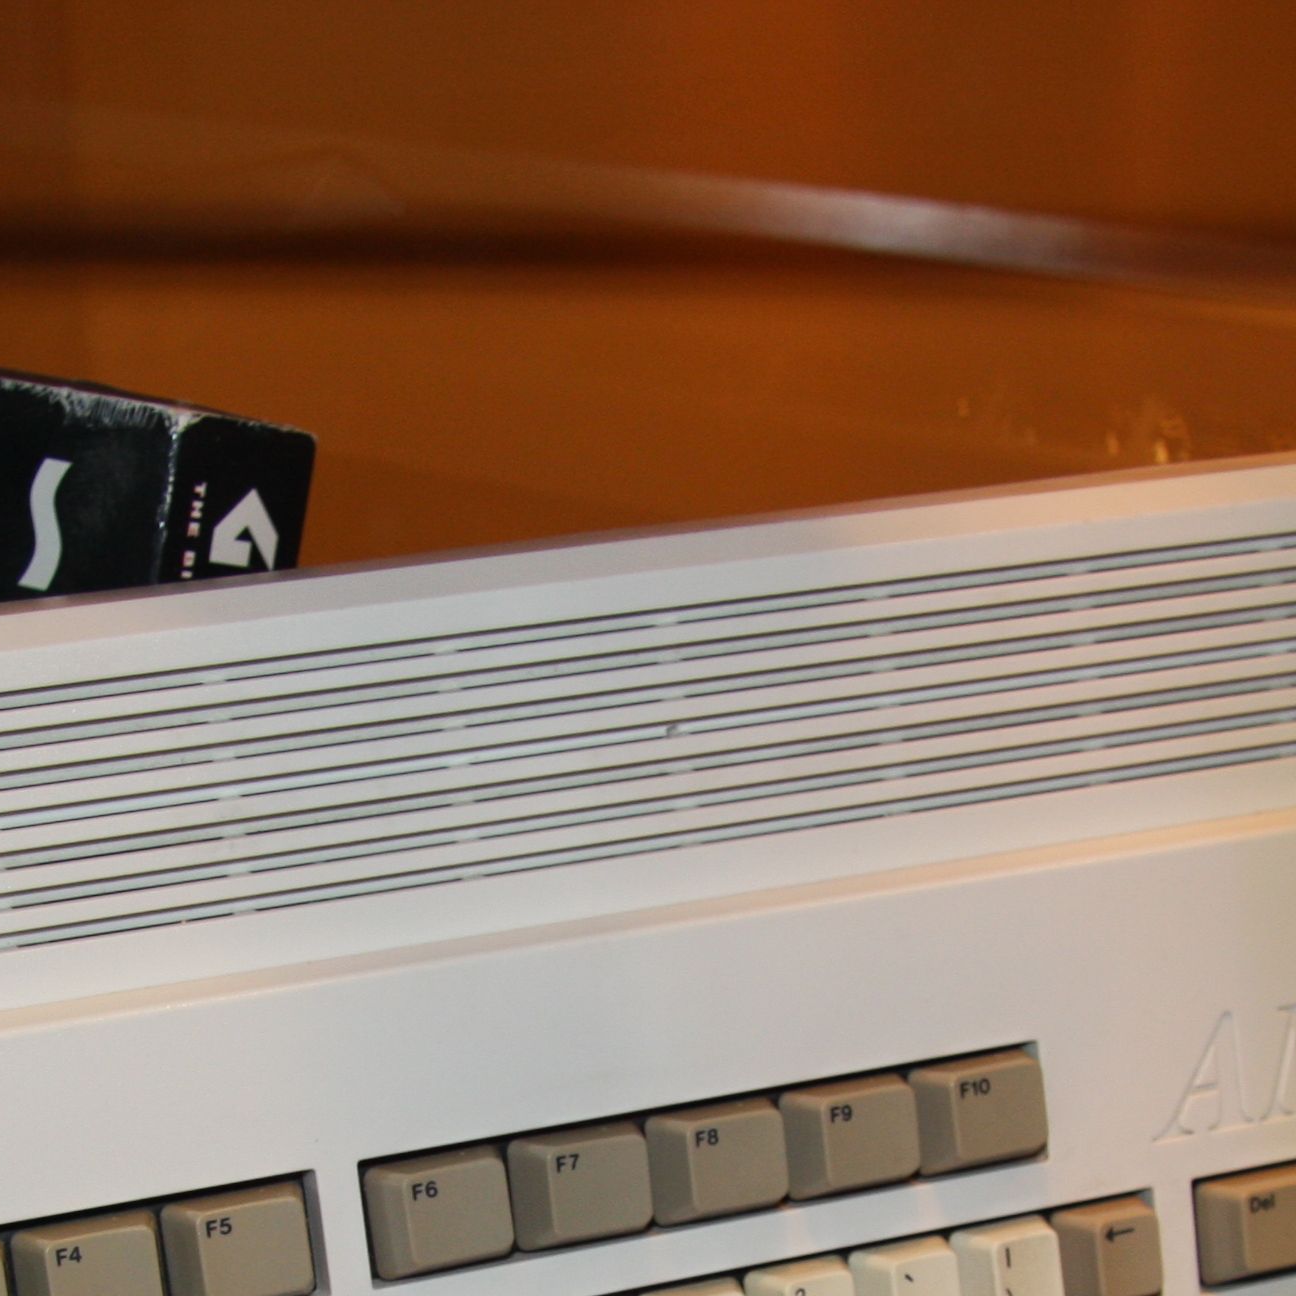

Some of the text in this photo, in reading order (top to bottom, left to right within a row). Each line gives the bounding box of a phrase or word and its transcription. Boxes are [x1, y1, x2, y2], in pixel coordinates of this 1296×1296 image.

[959, 1077, 991, 1099] F10
[830, 1105, 853, 1124] F9
[695, 1128, 719, 1147] F8
[555, 1154, 579, 1174] F7
[411, 1180, 439, 1200] F6
[205, 1216, 234, 1238] F5
[56, 1246, 83, 1267] F4
